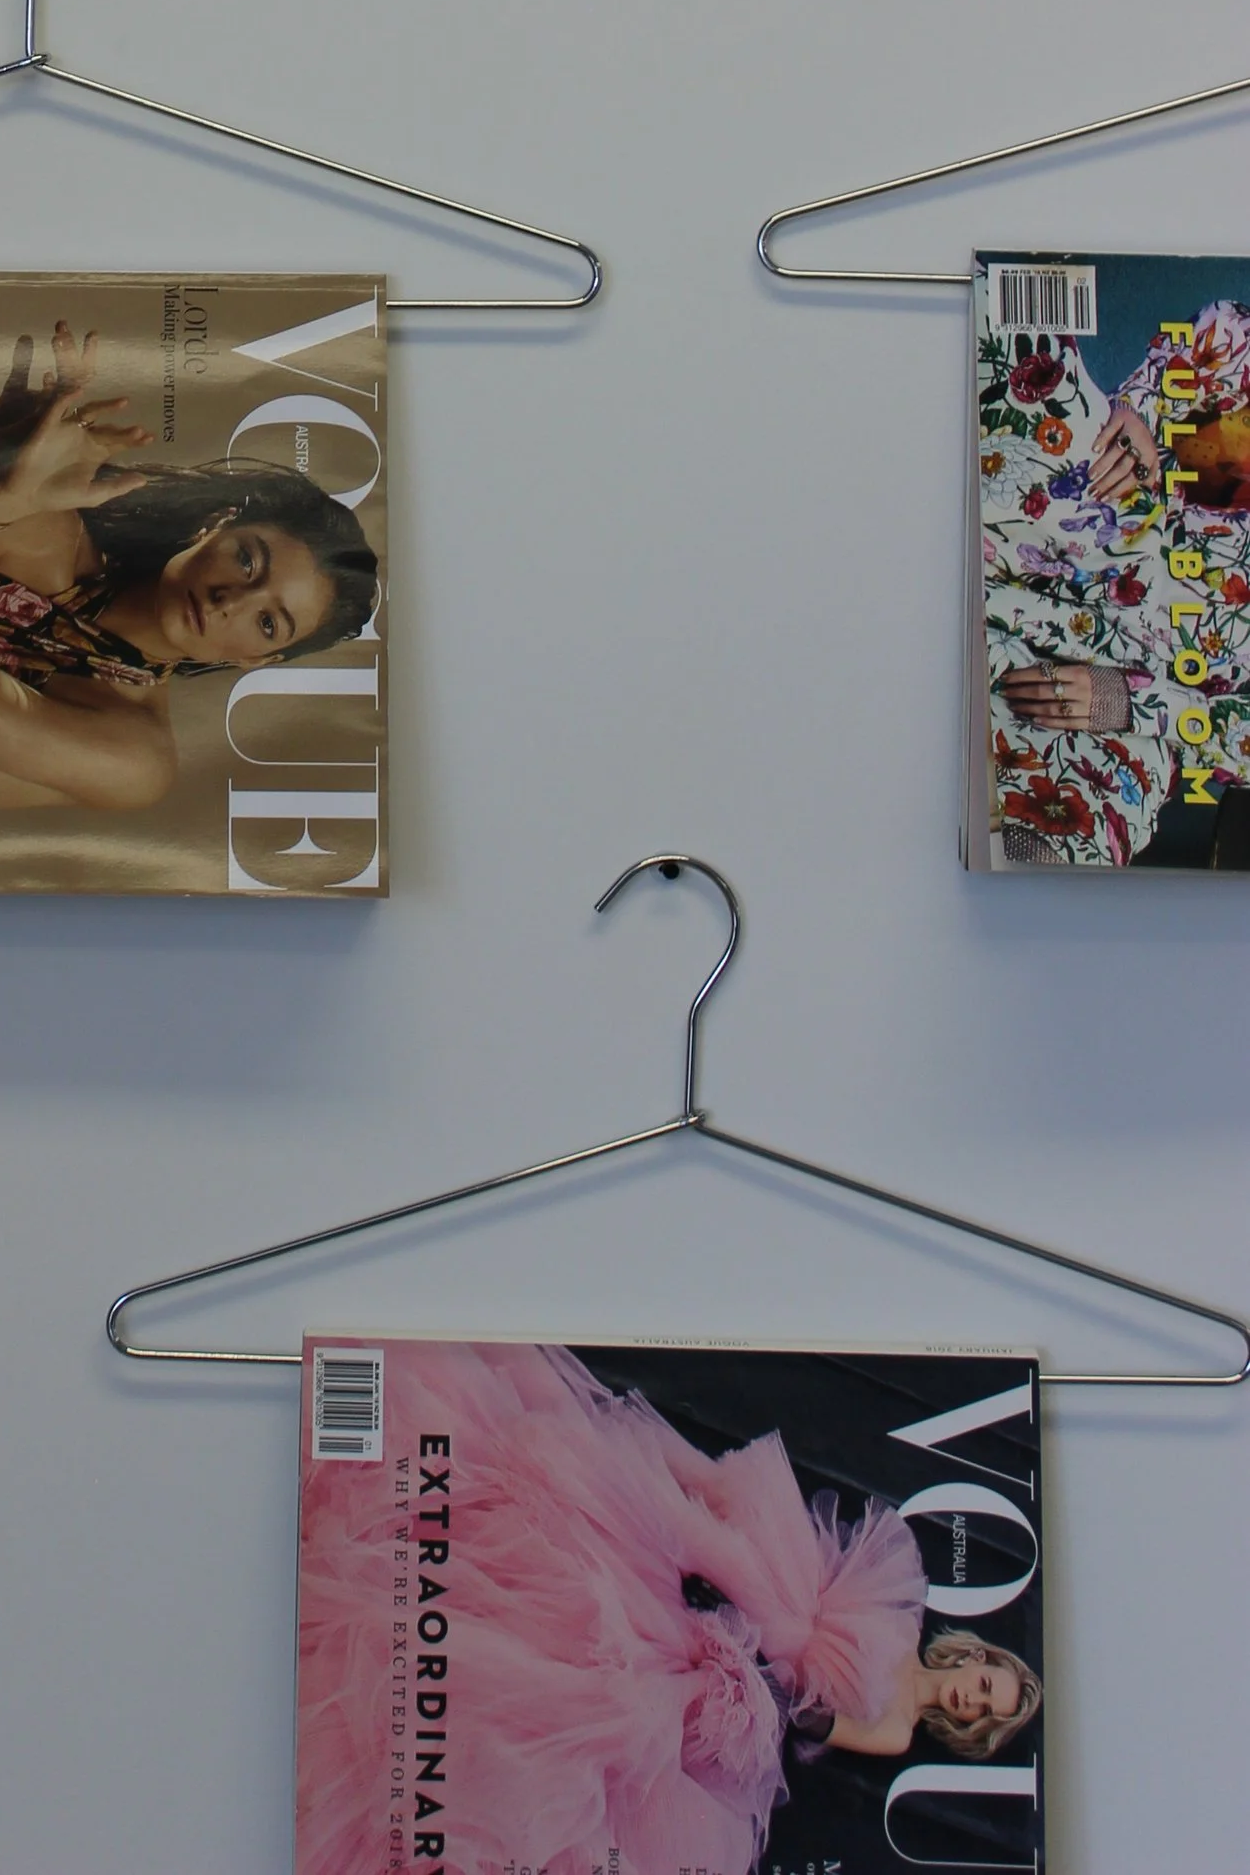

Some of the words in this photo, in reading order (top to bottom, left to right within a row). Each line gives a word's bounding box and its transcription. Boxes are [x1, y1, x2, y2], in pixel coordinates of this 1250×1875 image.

[161, 285, 180, 341] Making
[183, 287, 219, 374] Lorde
[163, 394, 176, 442] moves
[1159, 322, 1198, 495] FULL
[226, 285, 382, 891] VOUE
[1168, 552, 1218, 806] BLOOM
[394, 1457, 409, 1512] WHY
[393, 1527, 409, 1607] WE'RE
[951, 1513, 966, 1584] AUSTRALIA
[391, 1622, 409, 1737] EXCITED
[390, 1752, 404, 1801] FOR
